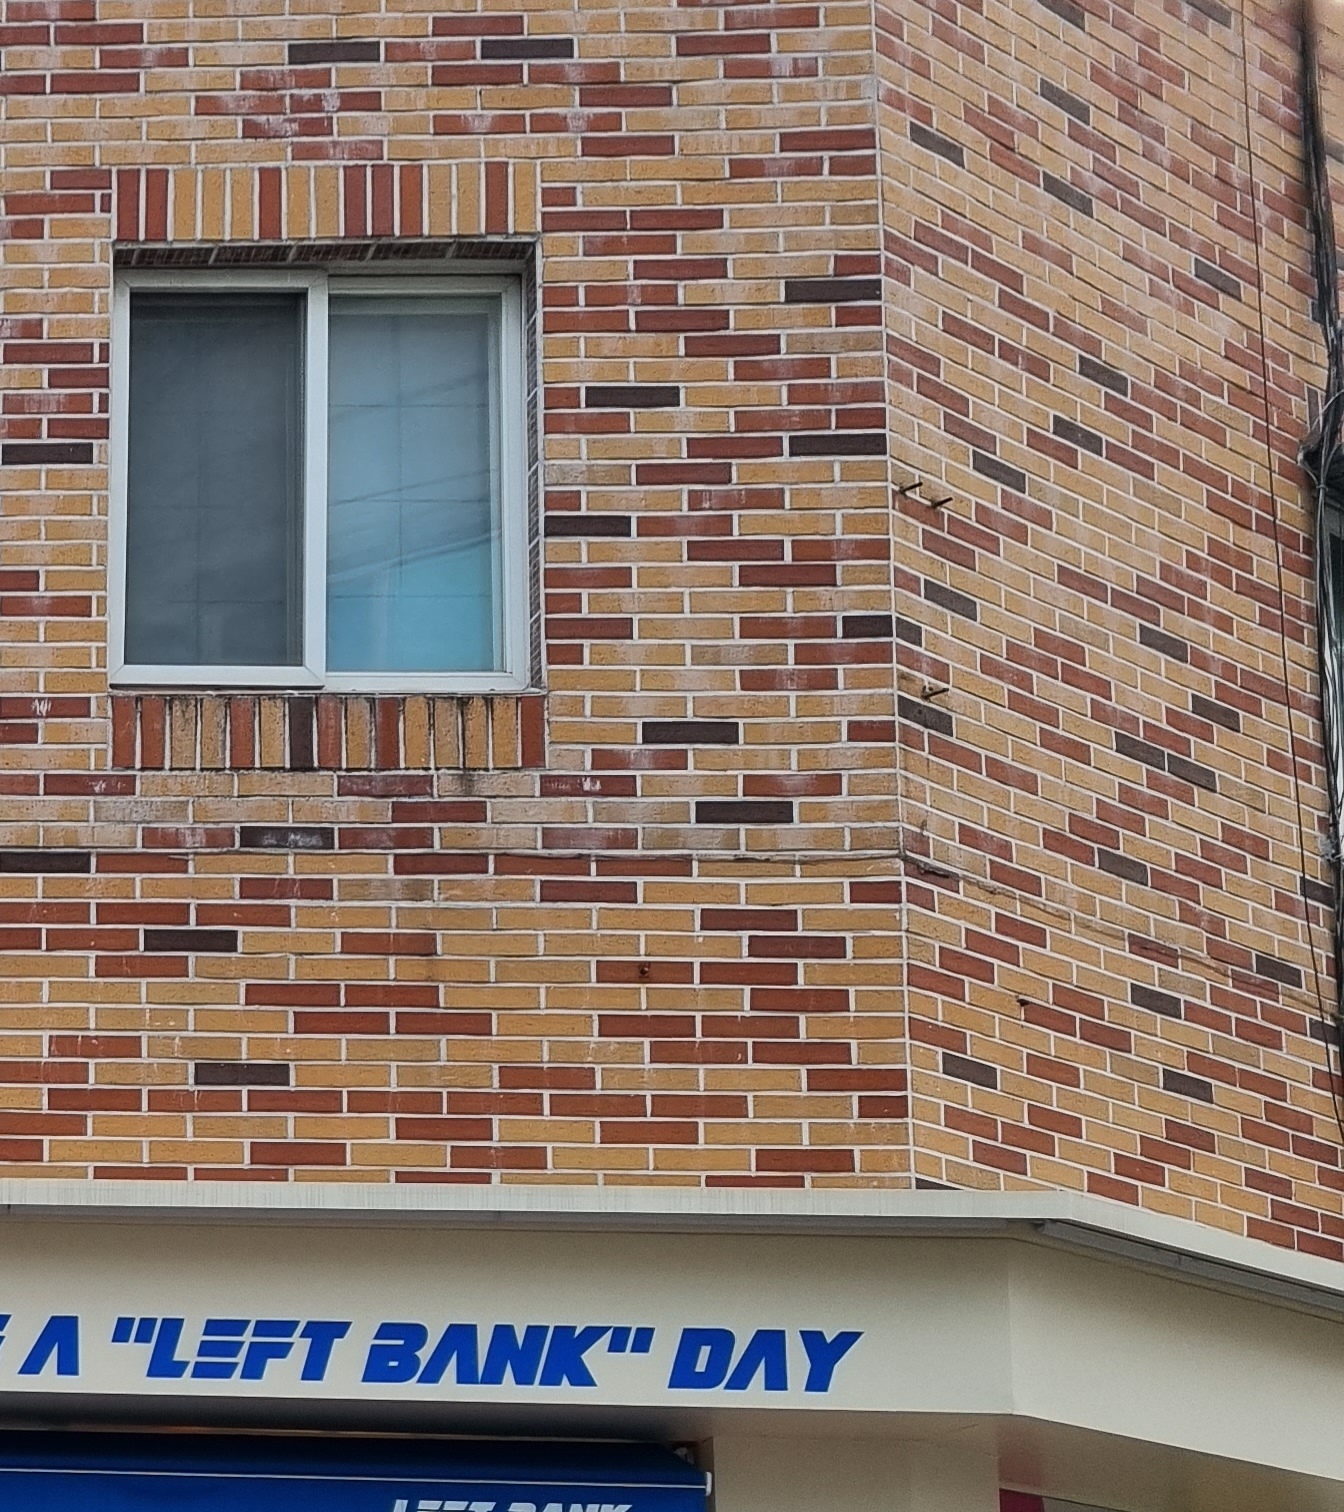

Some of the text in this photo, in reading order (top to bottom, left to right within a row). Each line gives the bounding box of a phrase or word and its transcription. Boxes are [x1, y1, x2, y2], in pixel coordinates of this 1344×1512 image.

[18, 1313, 81, 1376] A
[111, 1315, 352, 1386] "LEFT
[361, 1320, 656, 1389] BANK"
[669, 1326, 865, 1394] DAY
